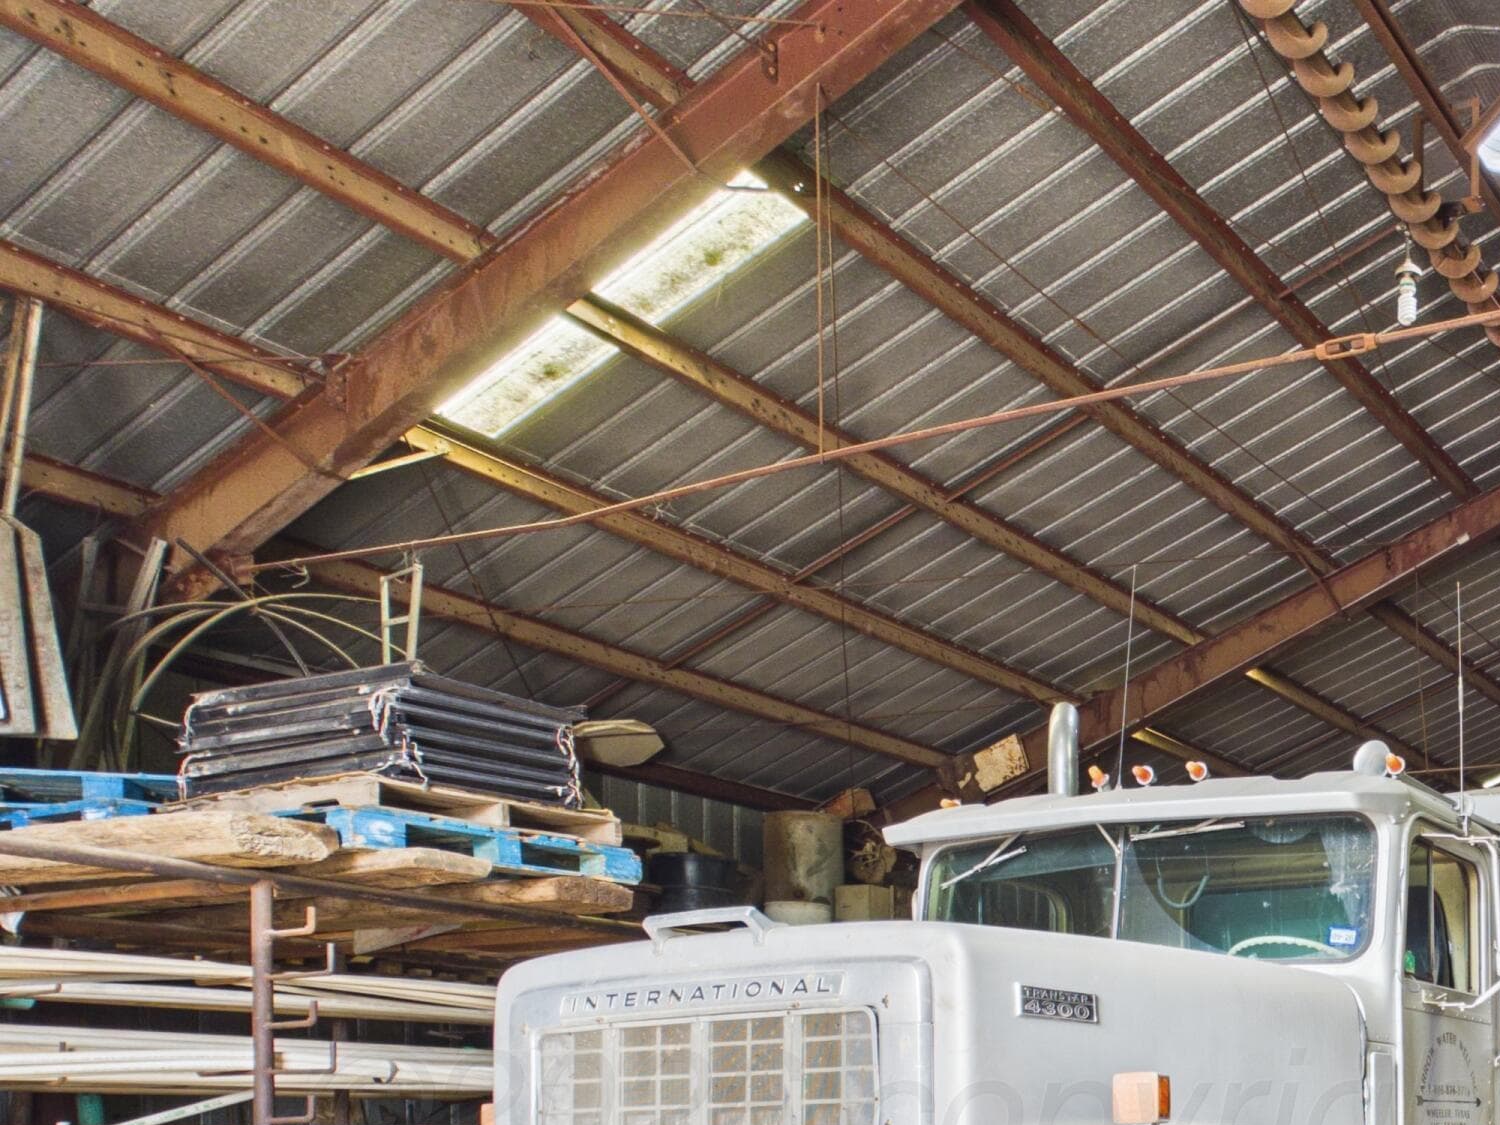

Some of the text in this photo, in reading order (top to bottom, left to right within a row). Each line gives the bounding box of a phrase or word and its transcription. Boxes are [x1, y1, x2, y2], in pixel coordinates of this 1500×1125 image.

[570, 976, 832, 1013] INTERNATIONAL
[1024, 987, 1088, 1003] TRANSTAR
[1024, 999, 1090, 1019] 4300
[1436, 1032, 1457, 1046] WATER
